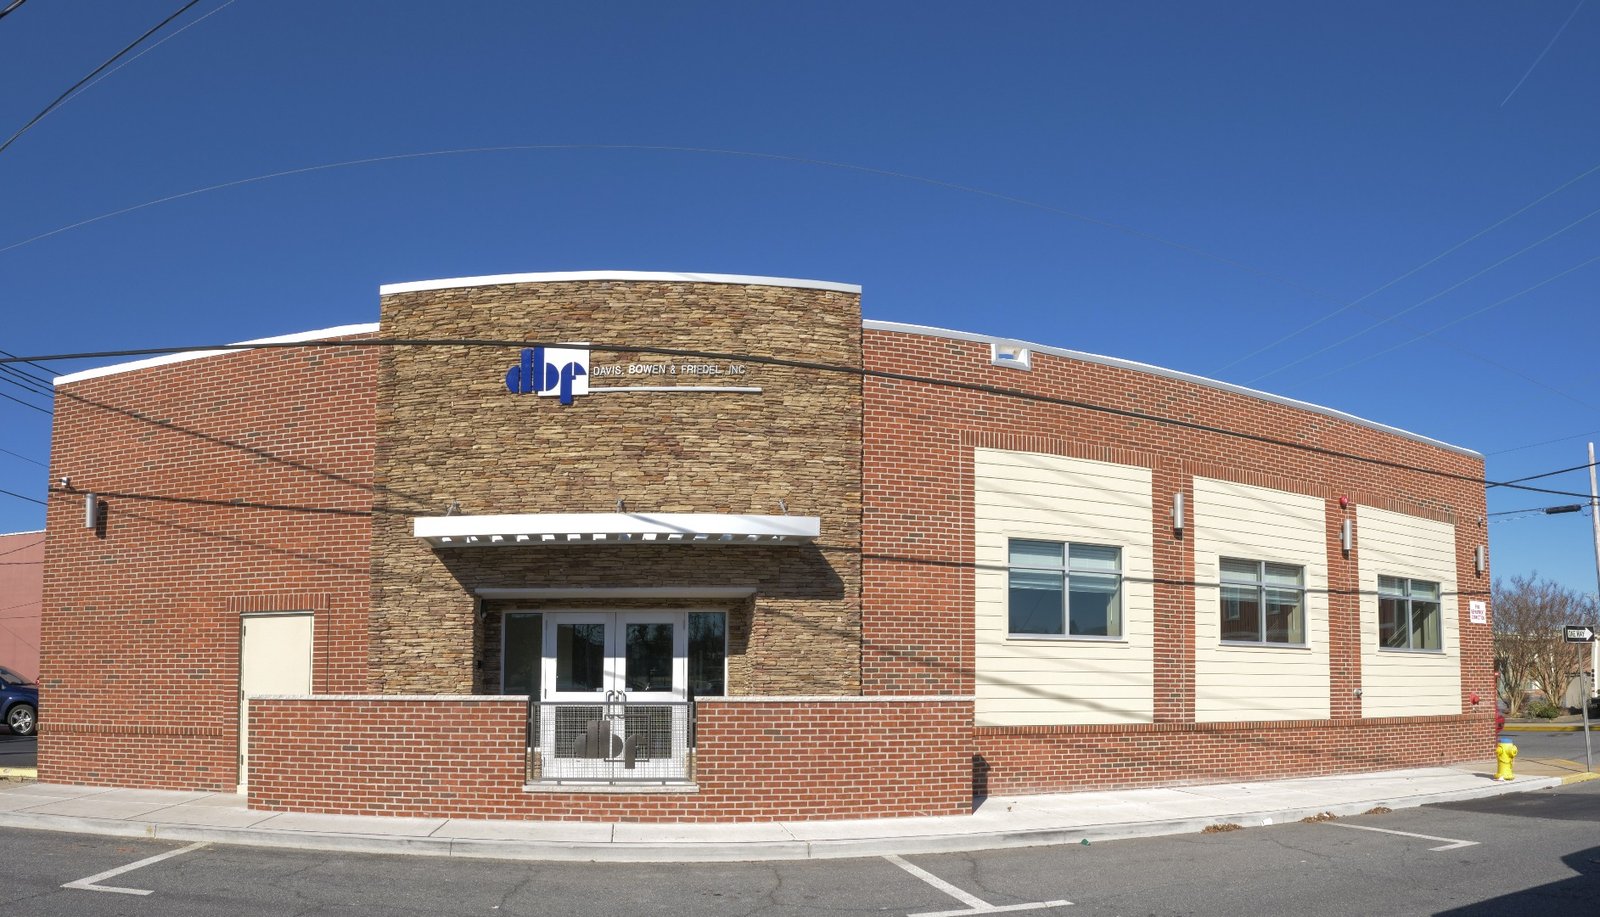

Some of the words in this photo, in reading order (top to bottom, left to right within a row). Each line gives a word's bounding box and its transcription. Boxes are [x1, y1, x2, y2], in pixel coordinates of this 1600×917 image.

[505, 345, 587, 404] dbf
[628, 364, 666, 374] BOWEN
[670, 365, 676, 374] &
[573, 720, 646, 769] dbf
